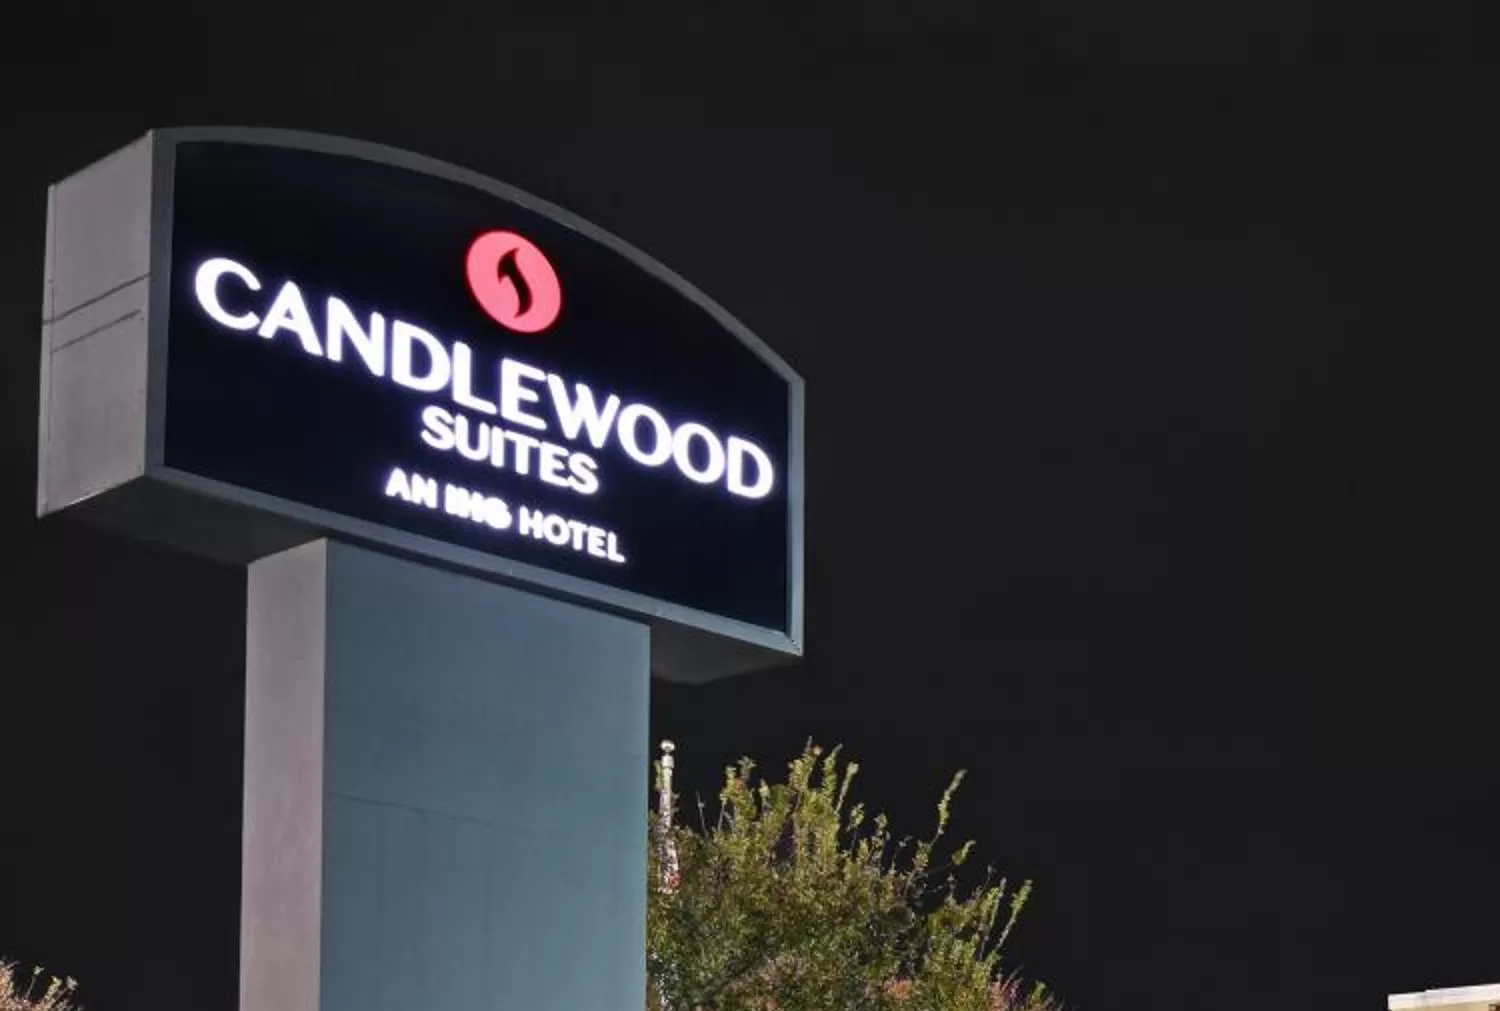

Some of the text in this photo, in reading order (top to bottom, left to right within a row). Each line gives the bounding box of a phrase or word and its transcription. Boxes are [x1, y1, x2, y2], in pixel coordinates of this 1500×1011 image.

[195, 257, 775, 500] CANDLEWOOD
[420, 405, 600, 495] SUITES
[384, 467, 438, 509] AN
[518, 505, 626, 563] HOTEL
